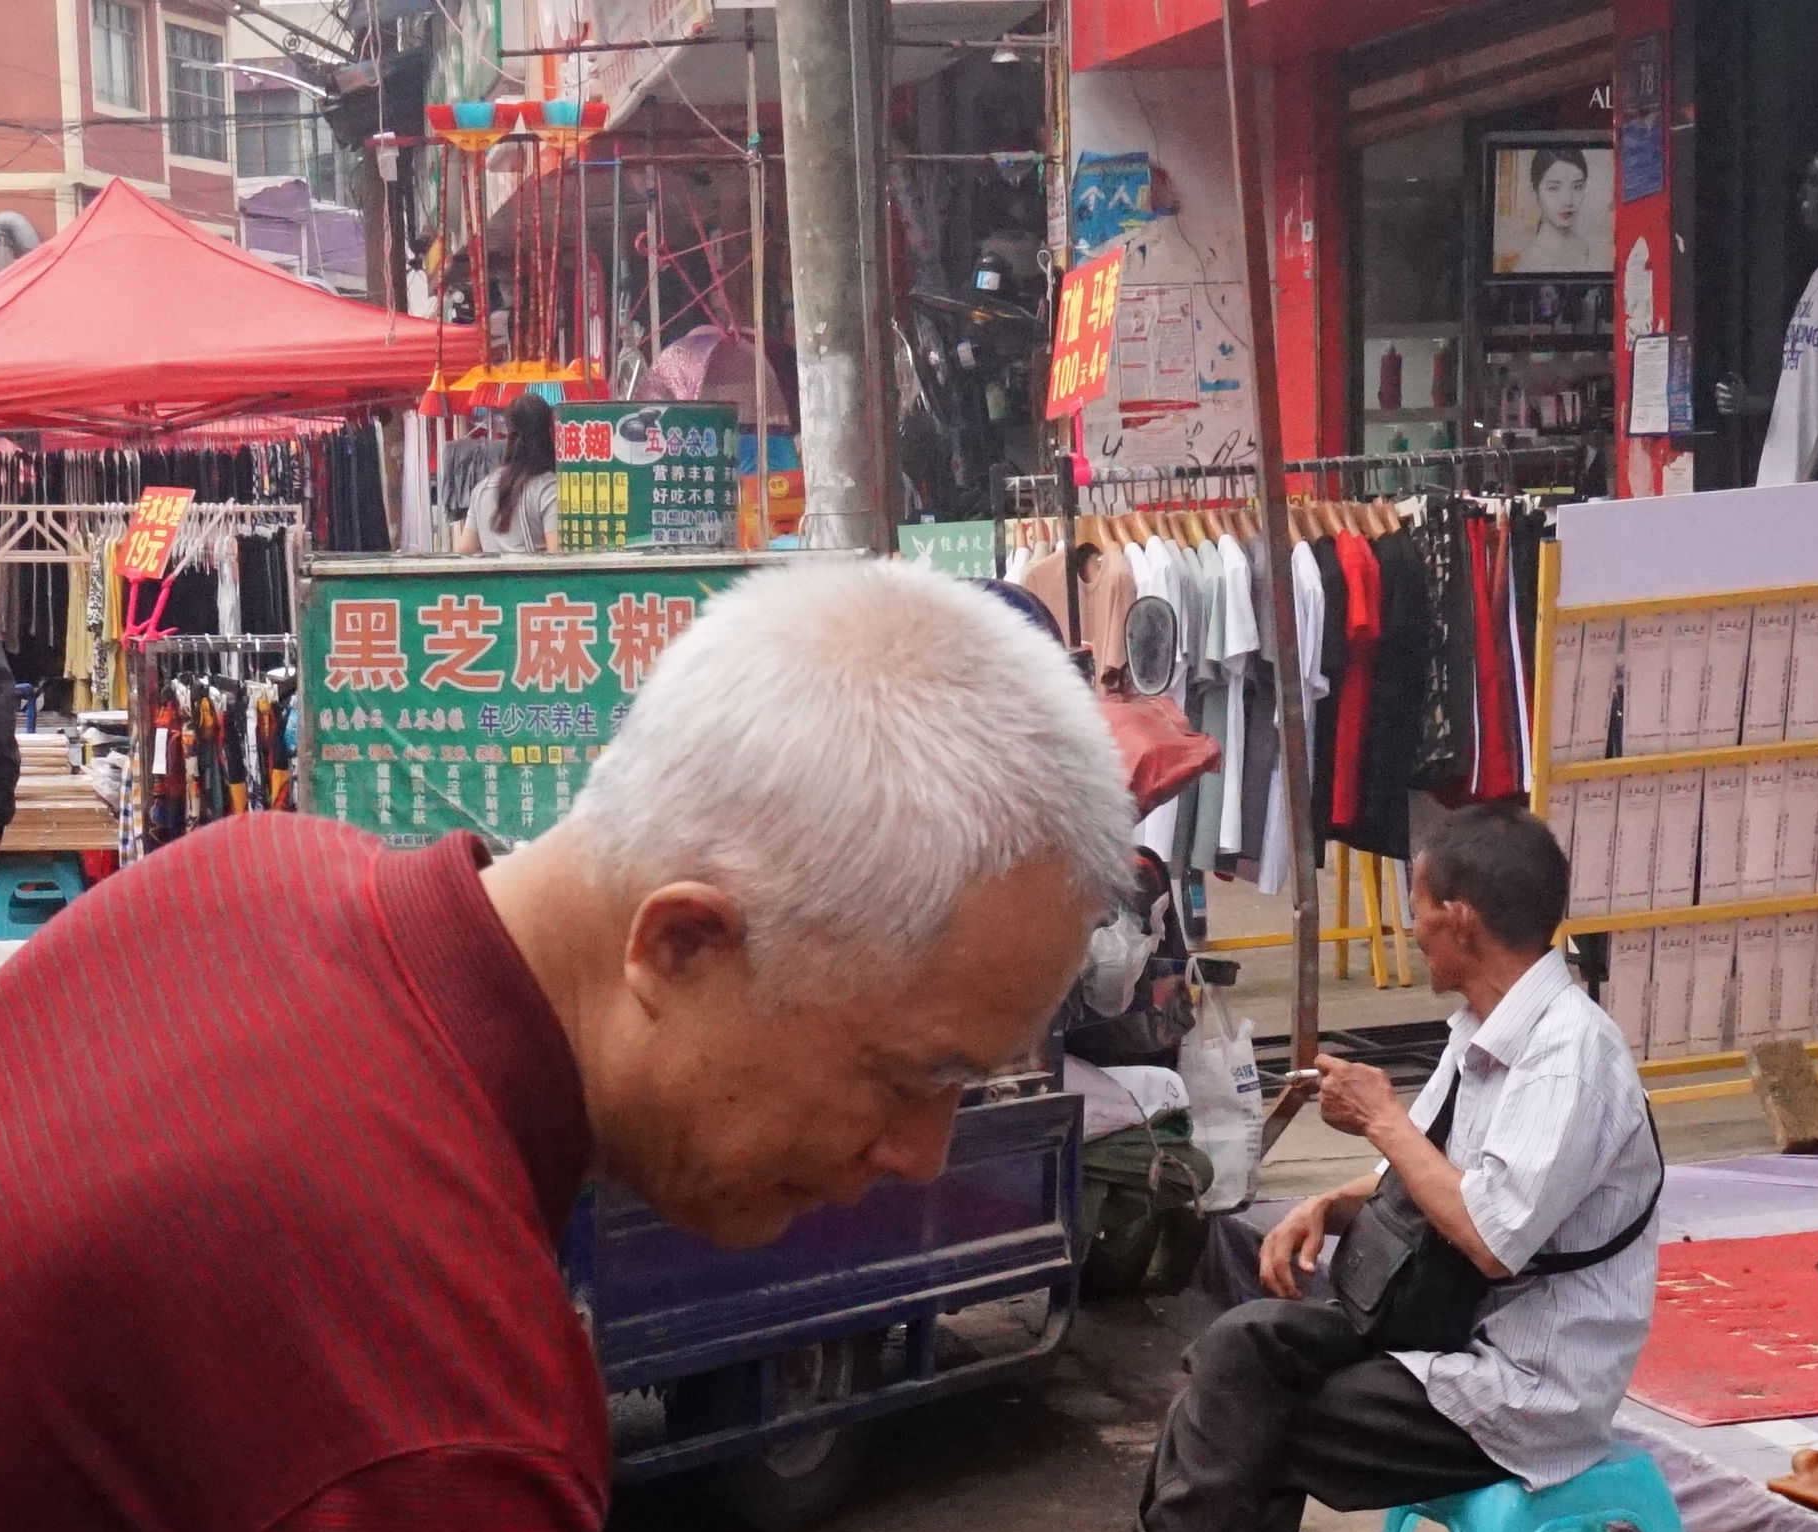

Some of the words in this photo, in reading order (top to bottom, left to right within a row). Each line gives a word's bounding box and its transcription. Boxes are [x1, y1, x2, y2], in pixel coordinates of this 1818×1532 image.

[124, 529, 168, 573] 19元
[324, 592, 696, 694] 黑芝麻糊
[478, 702, 599, 738] 年少不养生
